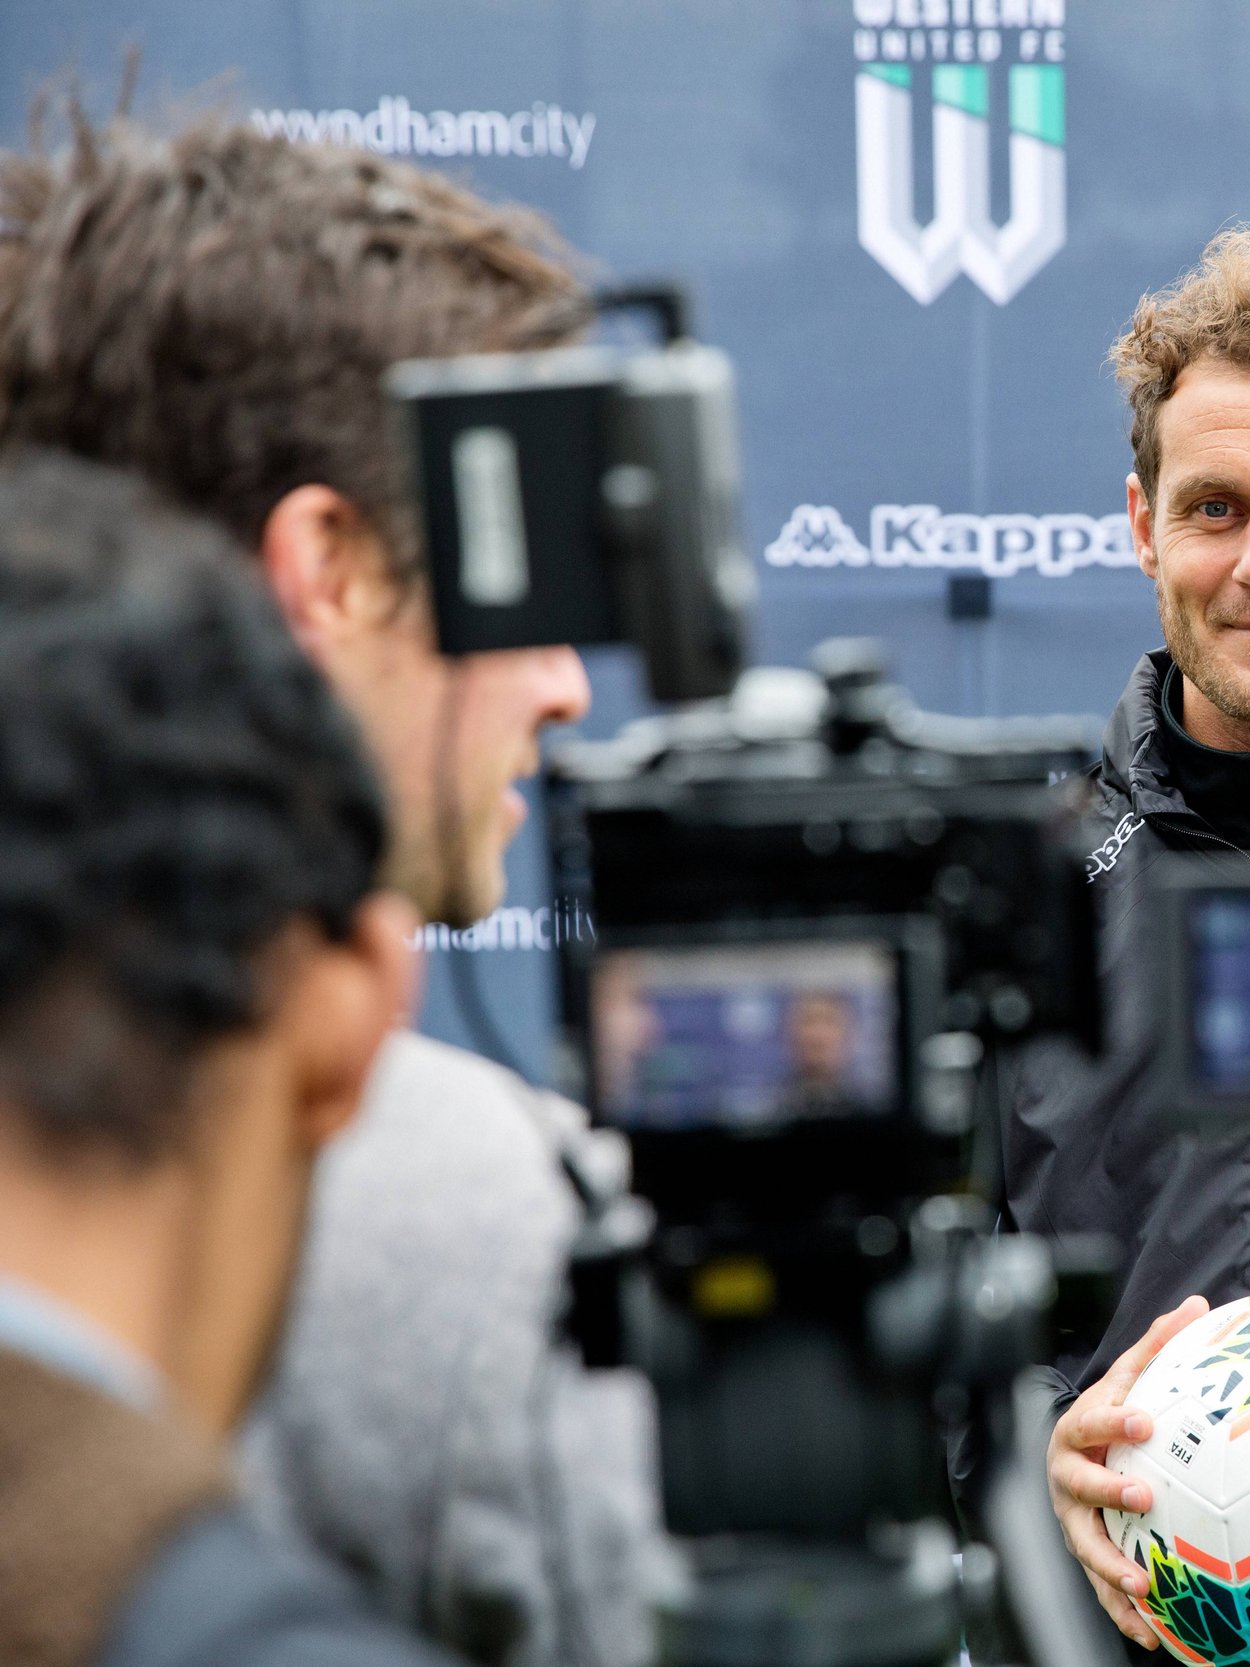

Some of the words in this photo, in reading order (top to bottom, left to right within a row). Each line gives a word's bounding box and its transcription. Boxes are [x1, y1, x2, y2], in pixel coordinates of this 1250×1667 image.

[854, 29, 1001, 61] UNITED
[1020, 29, 1066, 61] FC
[252, 96, 596, 170] wyndhamcity
[871, 504, 1140, 577] Kappa
[1171, 1441, 1192, 1464] FIFA
